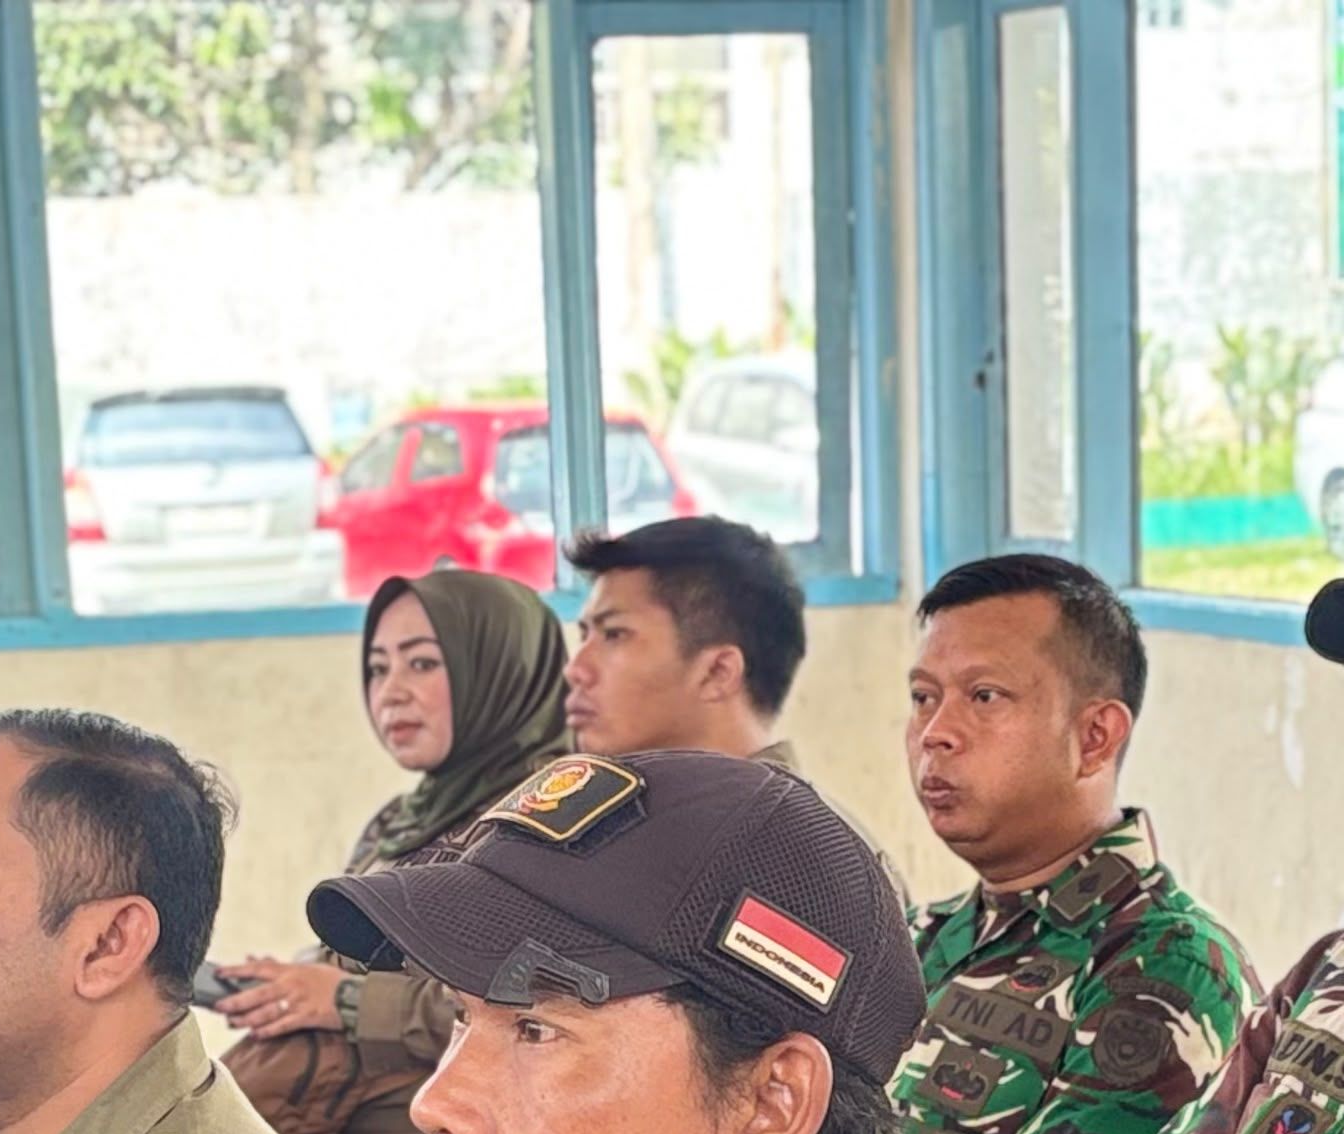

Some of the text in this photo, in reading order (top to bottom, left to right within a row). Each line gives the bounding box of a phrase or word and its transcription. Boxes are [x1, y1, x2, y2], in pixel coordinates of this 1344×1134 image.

[735, 932, 825, 994] INDONESIA
[948, 992, 1055, 1046] TNI AD
